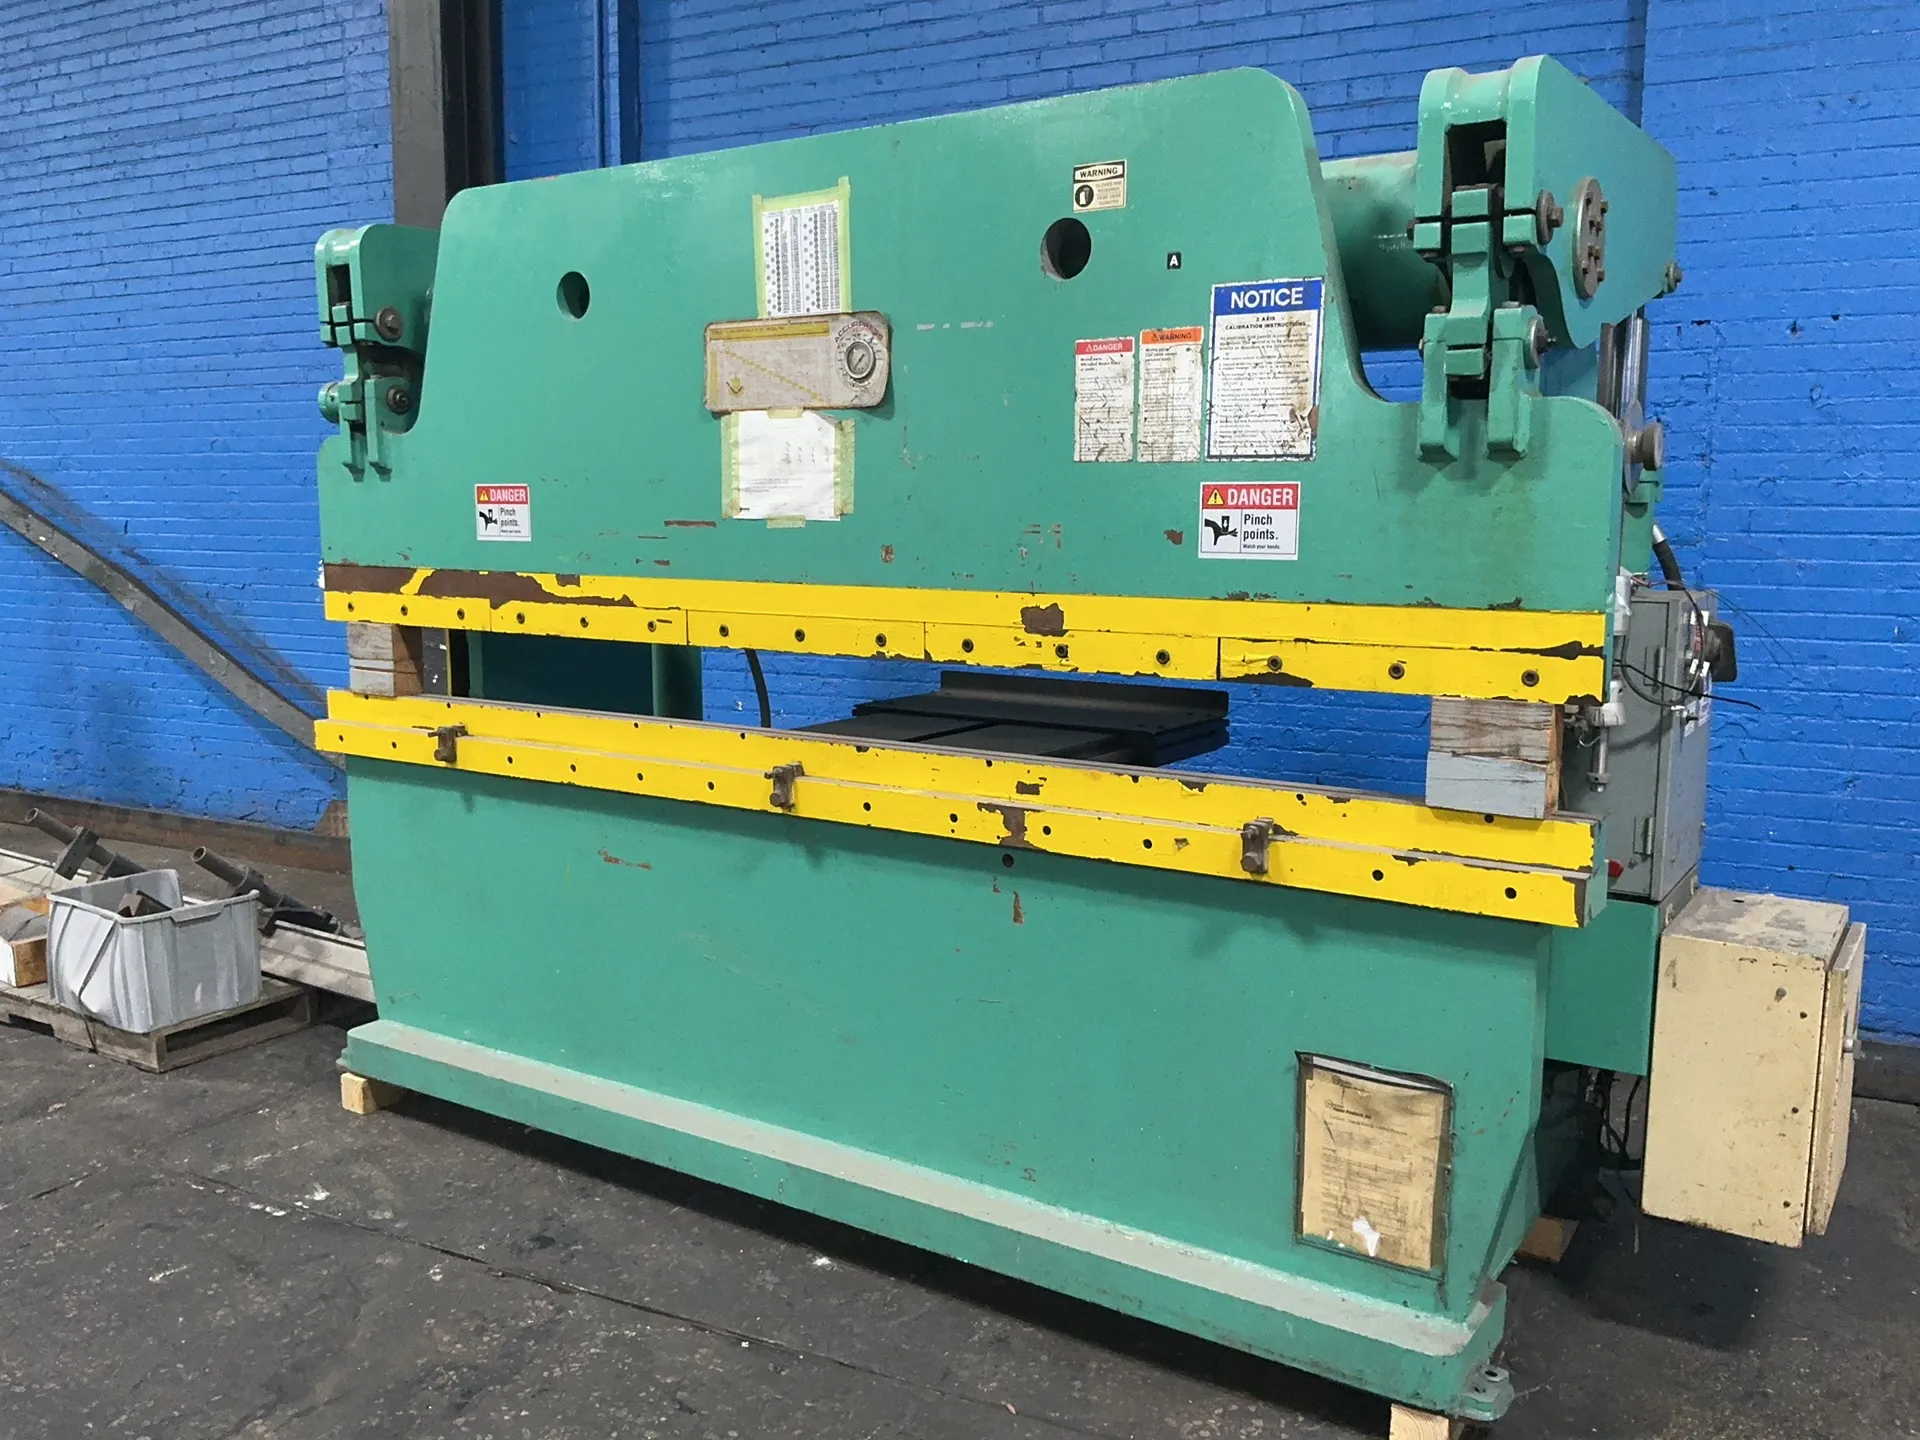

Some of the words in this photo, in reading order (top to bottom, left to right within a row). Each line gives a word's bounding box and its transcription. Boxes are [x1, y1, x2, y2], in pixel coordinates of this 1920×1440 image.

[1080, 167, 1118, 178] WARNING
[1170, 254, 1179, 267] A
[1230, 287, 1304, 309] NOTICE
[1159, 332, 1192, 340] WARNING
[1092, 343, 1123, 352] DANGER
[490, 488, 526, 502] DANGER
[1227, 488, 1294, 506] DANGER
[1243, 513, 1273, 526] Pinch
[1243, 528, 1279, 542] points.
